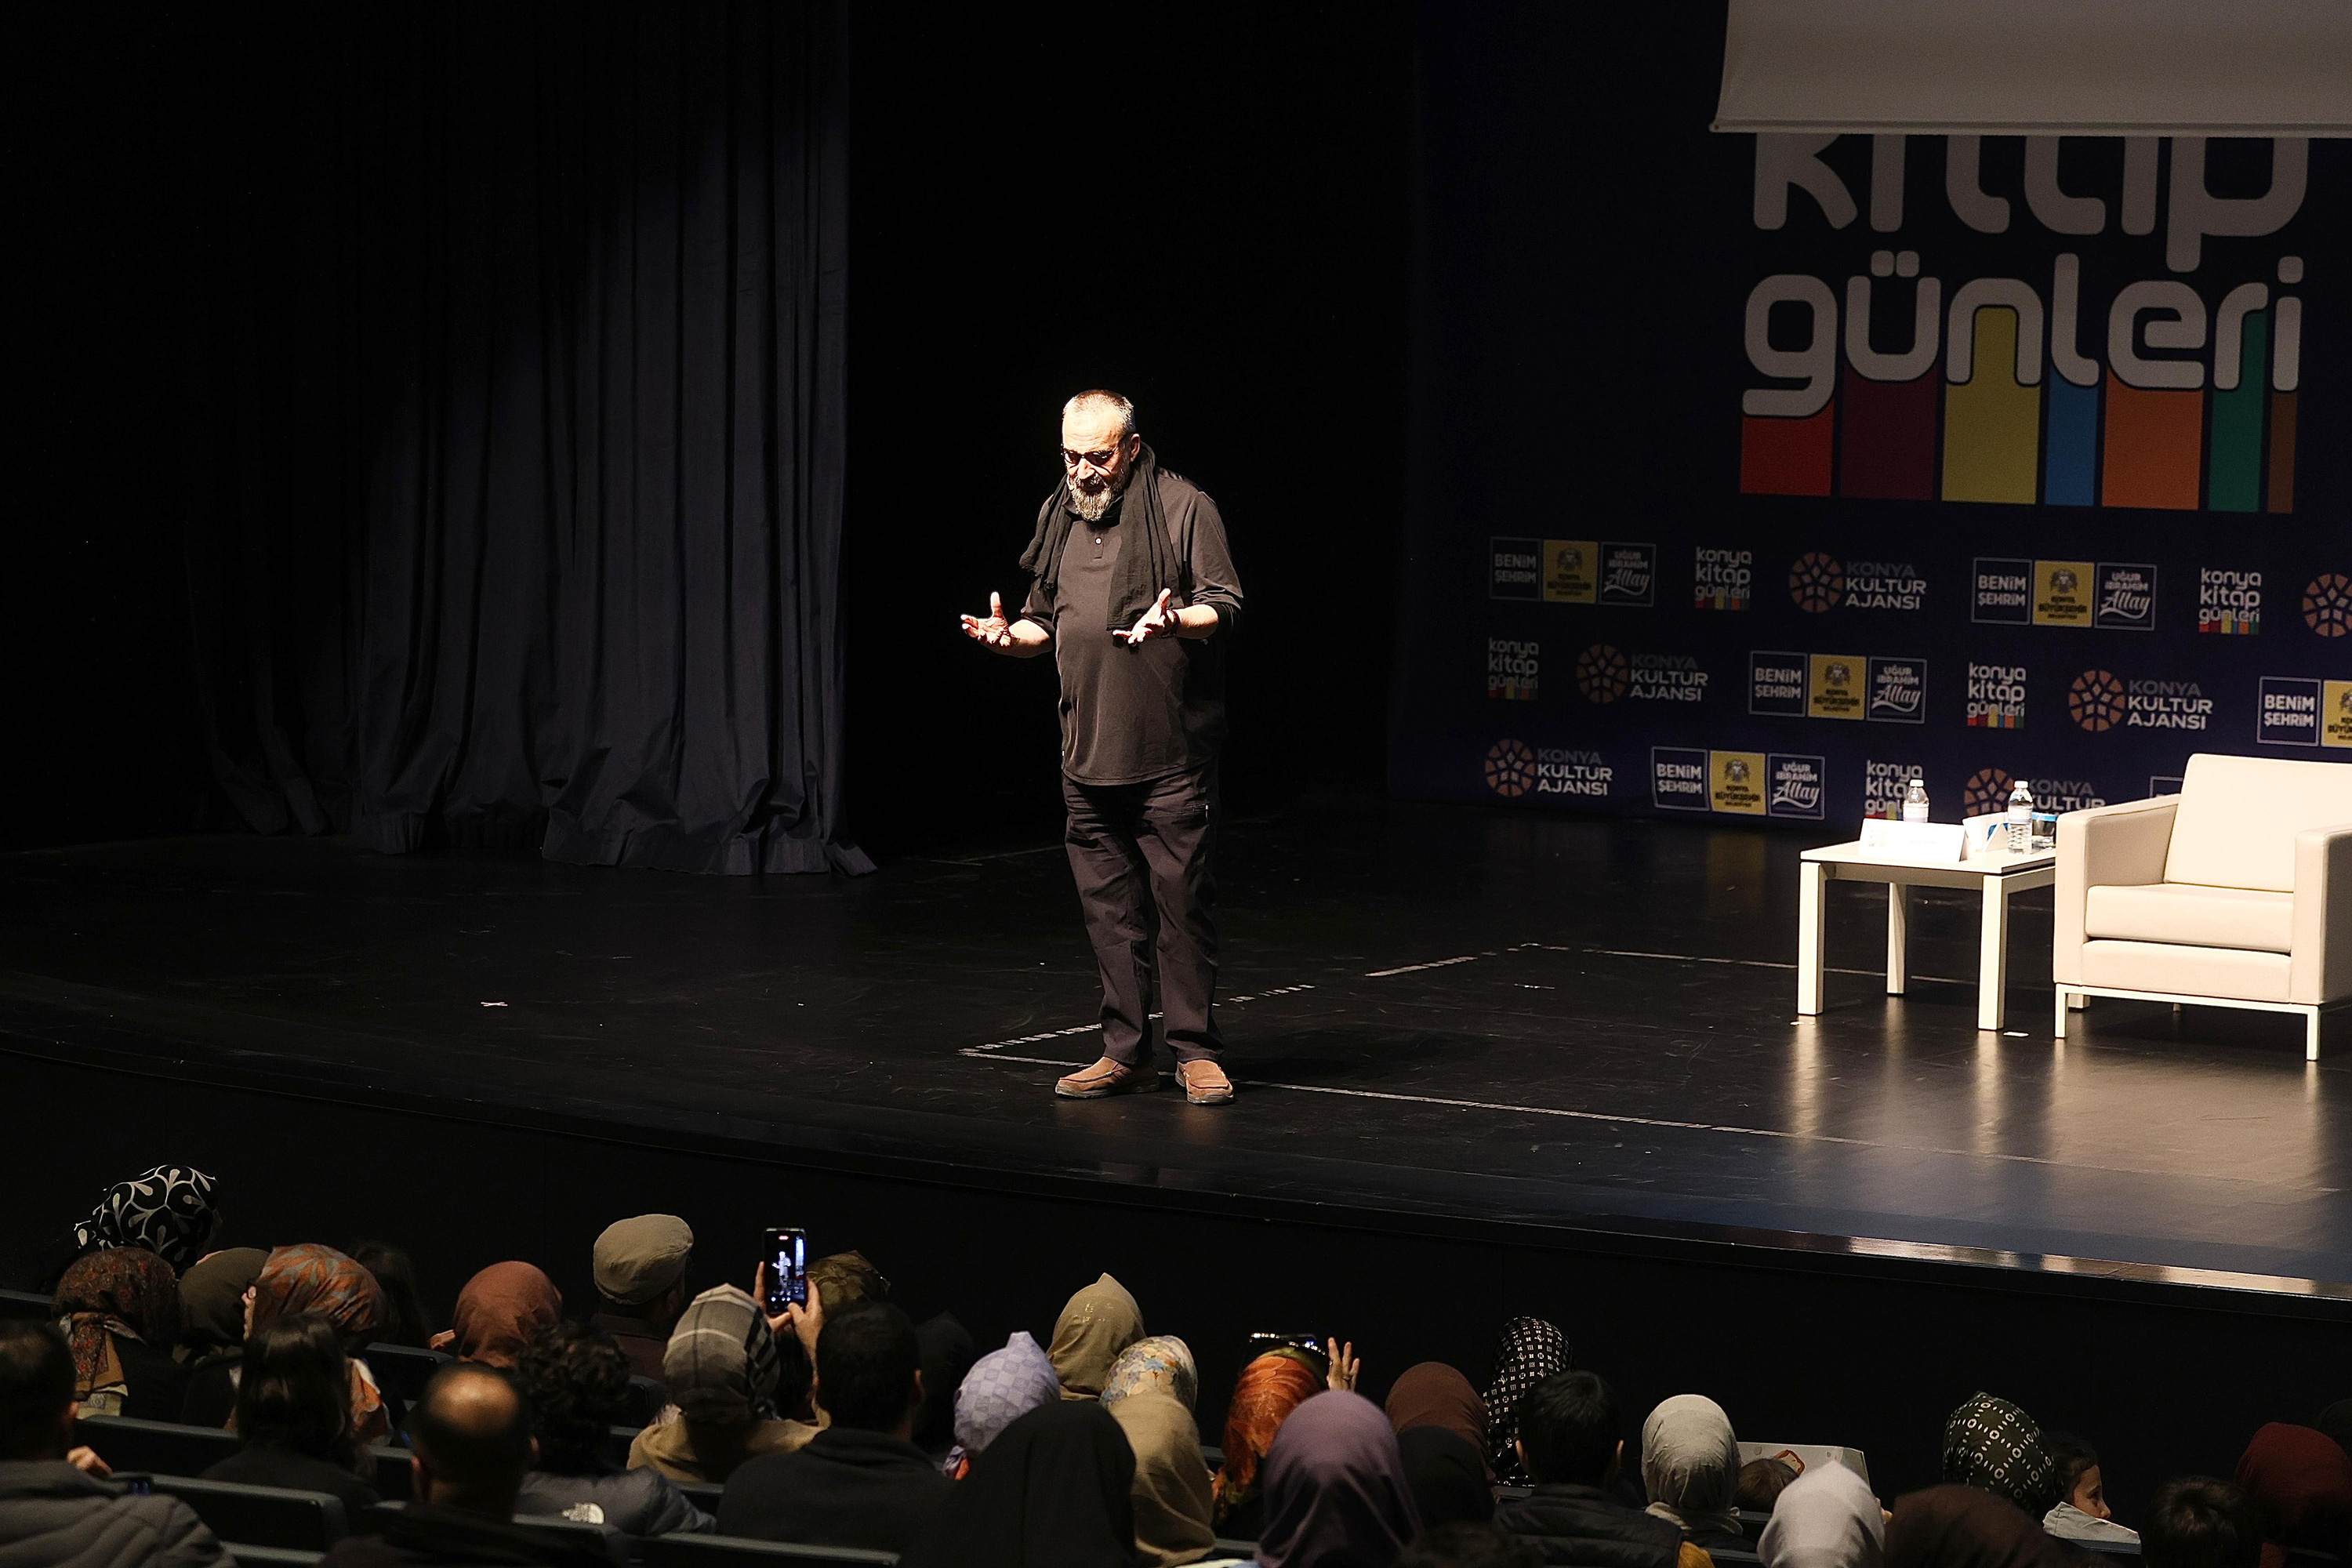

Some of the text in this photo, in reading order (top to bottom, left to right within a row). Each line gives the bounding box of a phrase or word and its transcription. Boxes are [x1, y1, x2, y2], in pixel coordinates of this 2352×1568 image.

[1742, 250, 2303, 417] günleri
[1695, 546, 1753, 568] konya
[1694, 562, 1751, 586] kitap
[1846, 561, 1915, 578] KONYA
[2201, 567, 2262, 590] konya
[1978, 575, 2027, 591] BENİM
[1845, 593, 1921, 610] AJANSI
[2199, 585, 2261, 610] kitap
[1489, 637, 1539, 658] konya
[1488, 653, 1538, 677] kitap
[1631, 654, 1698, 670] KONYA
[1755, 668, 1802, 684] BENİM
[1969, 662, 2026, 684] konya
[1630, 685, 1702, 702] AJANSI
[1968, 680, 2025, 703] kitap
[2129, 679, 2201, 697] KONYA
[2264, 693, 2315, 712] BENİM
[2127, 712, 2206, 730] AJANSI
[1537, 748, 1602, 765] KONYA
[1657, 763, 1702, 780] BENİM
[1867, 759, 1923, 783] konya
[1537, 778, 1609, 797] AJANSI
[1866, 777, 1907, 798] kita
